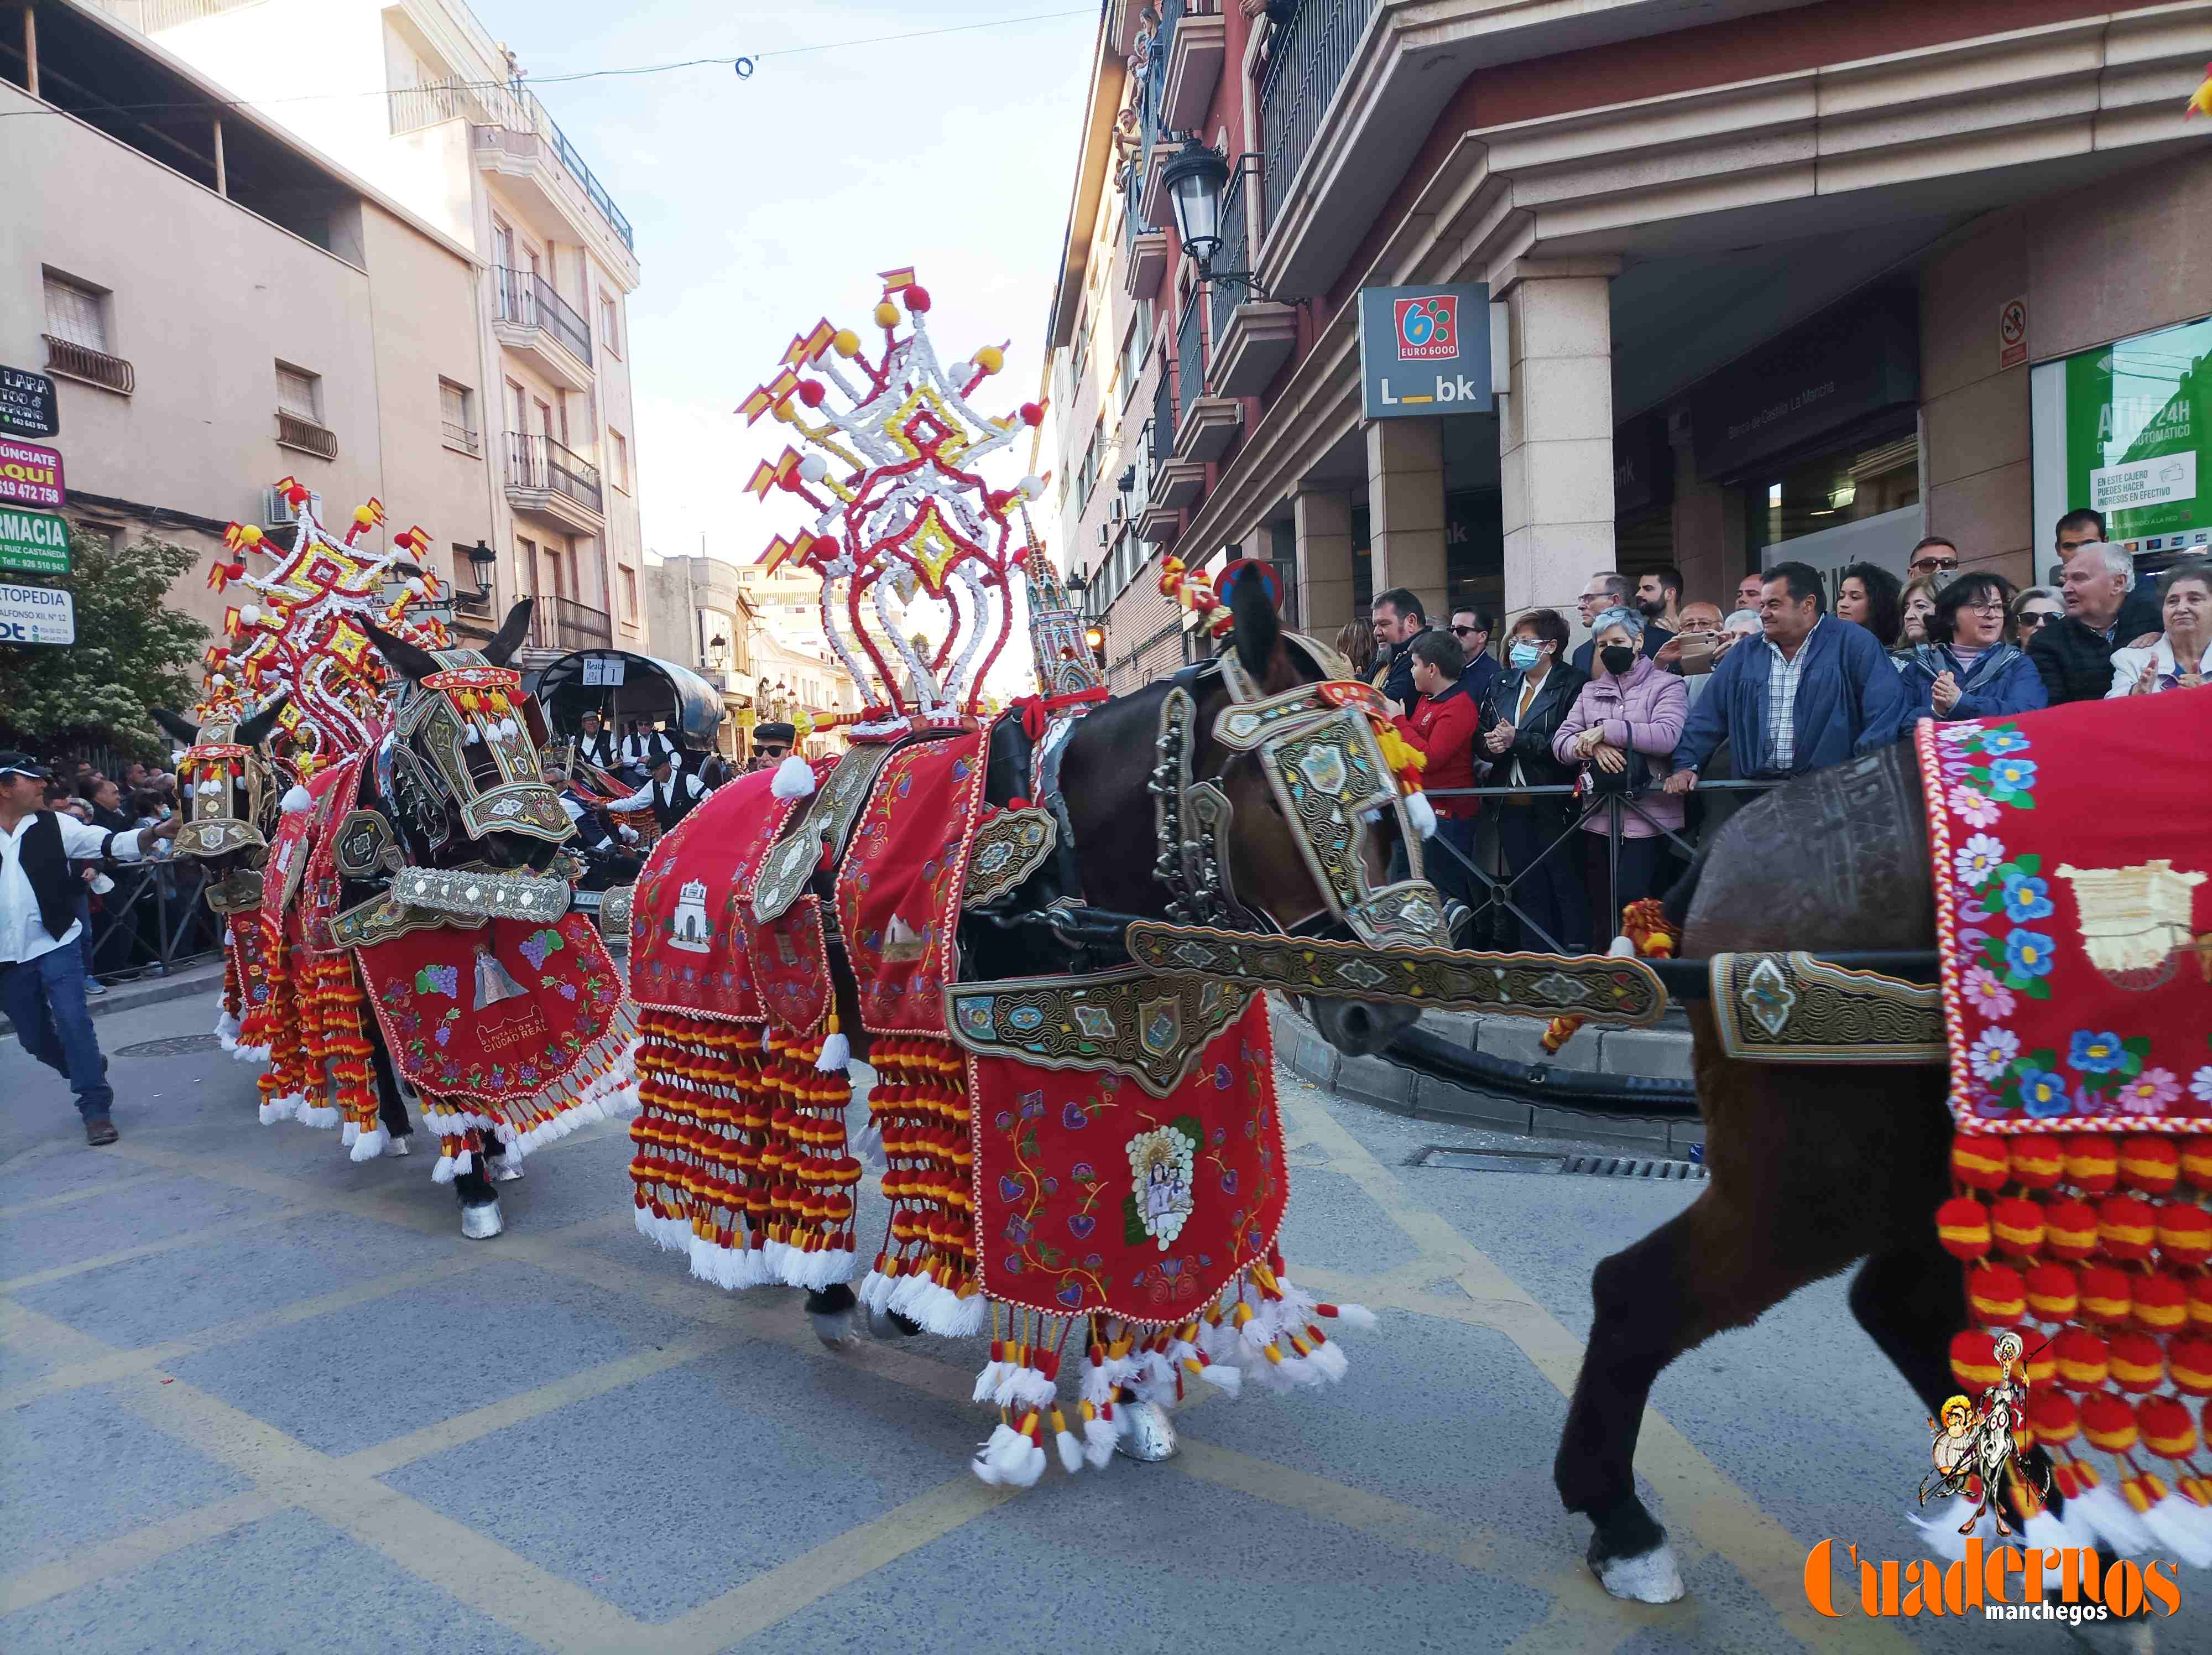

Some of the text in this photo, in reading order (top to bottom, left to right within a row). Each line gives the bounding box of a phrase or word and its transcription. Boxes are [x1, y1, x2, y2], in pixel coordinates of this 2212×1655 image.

[1401, 345, 1455, 357] EURO 6000
[4, 371, 49, 395] LARA
[1728, 381, 1837, 439] Banco de Castilla La Mancha
[2156, 399, 2190, 427] 24H
[2098, 469, 2148, 487] EN ESTE CAJERO
[18, 483, 38, 499] 472
[39, 487, 59, 503] 758
[2098, 481, 2144, 496] PUEDES HACER
[2098, 486, 2171, 507] INGRESOS EN EFECTIVO
[4, 545, 22, 554] RUIZ
[23, 547, 66, 559] CASTAÑEDA
[611, 668, 615, 681] 1
[484, 1024, 549, 1053] CIUDAD REAL
